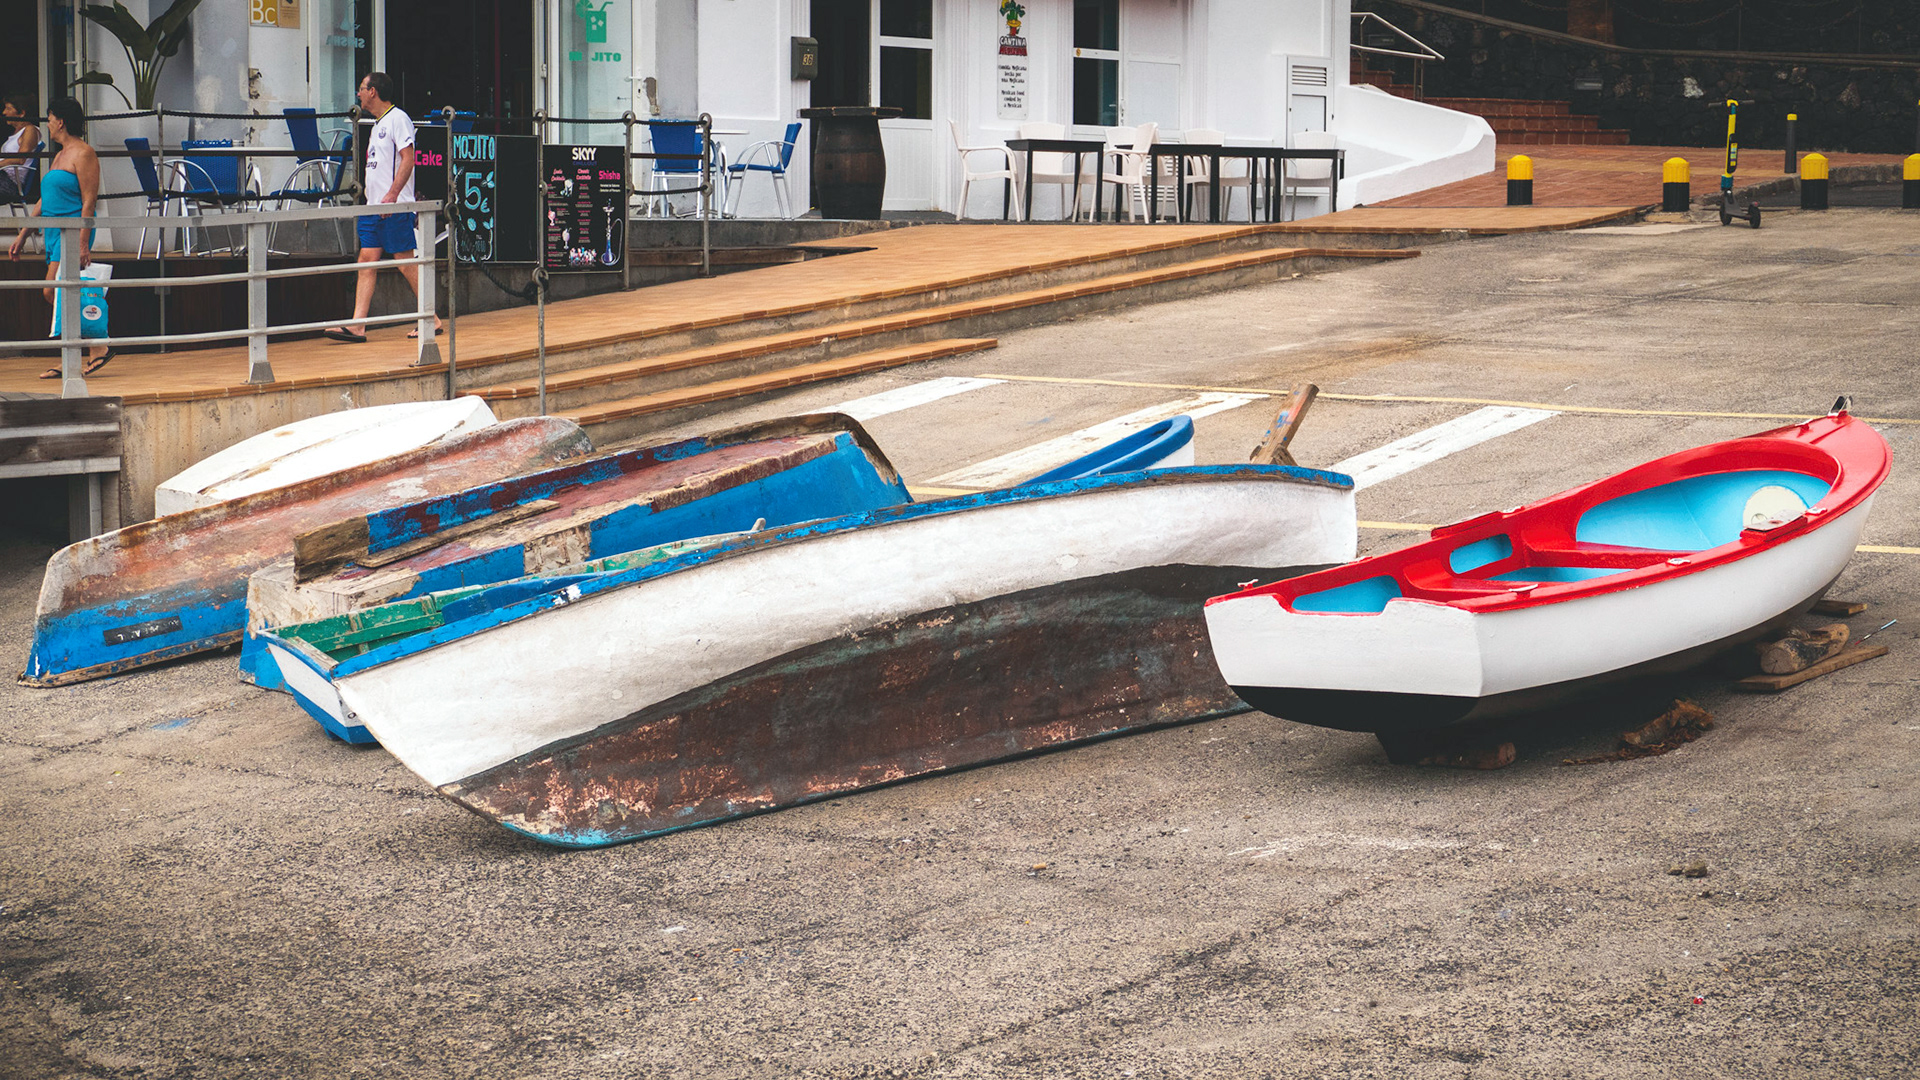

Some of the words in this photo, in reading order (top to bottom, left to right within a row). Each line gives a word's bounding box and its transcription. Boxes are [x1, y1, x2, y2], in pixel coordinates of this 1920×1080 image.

[251, 0, 276, 24] Bc
[999, 36, 1027, 47] CANTINA
[453, 135, 495, 160] MOJITO
[572, 147, 597, 160] SKYY
[415, 150, 442, 166] Cake
[598, 169, 620, 180] Shisha
